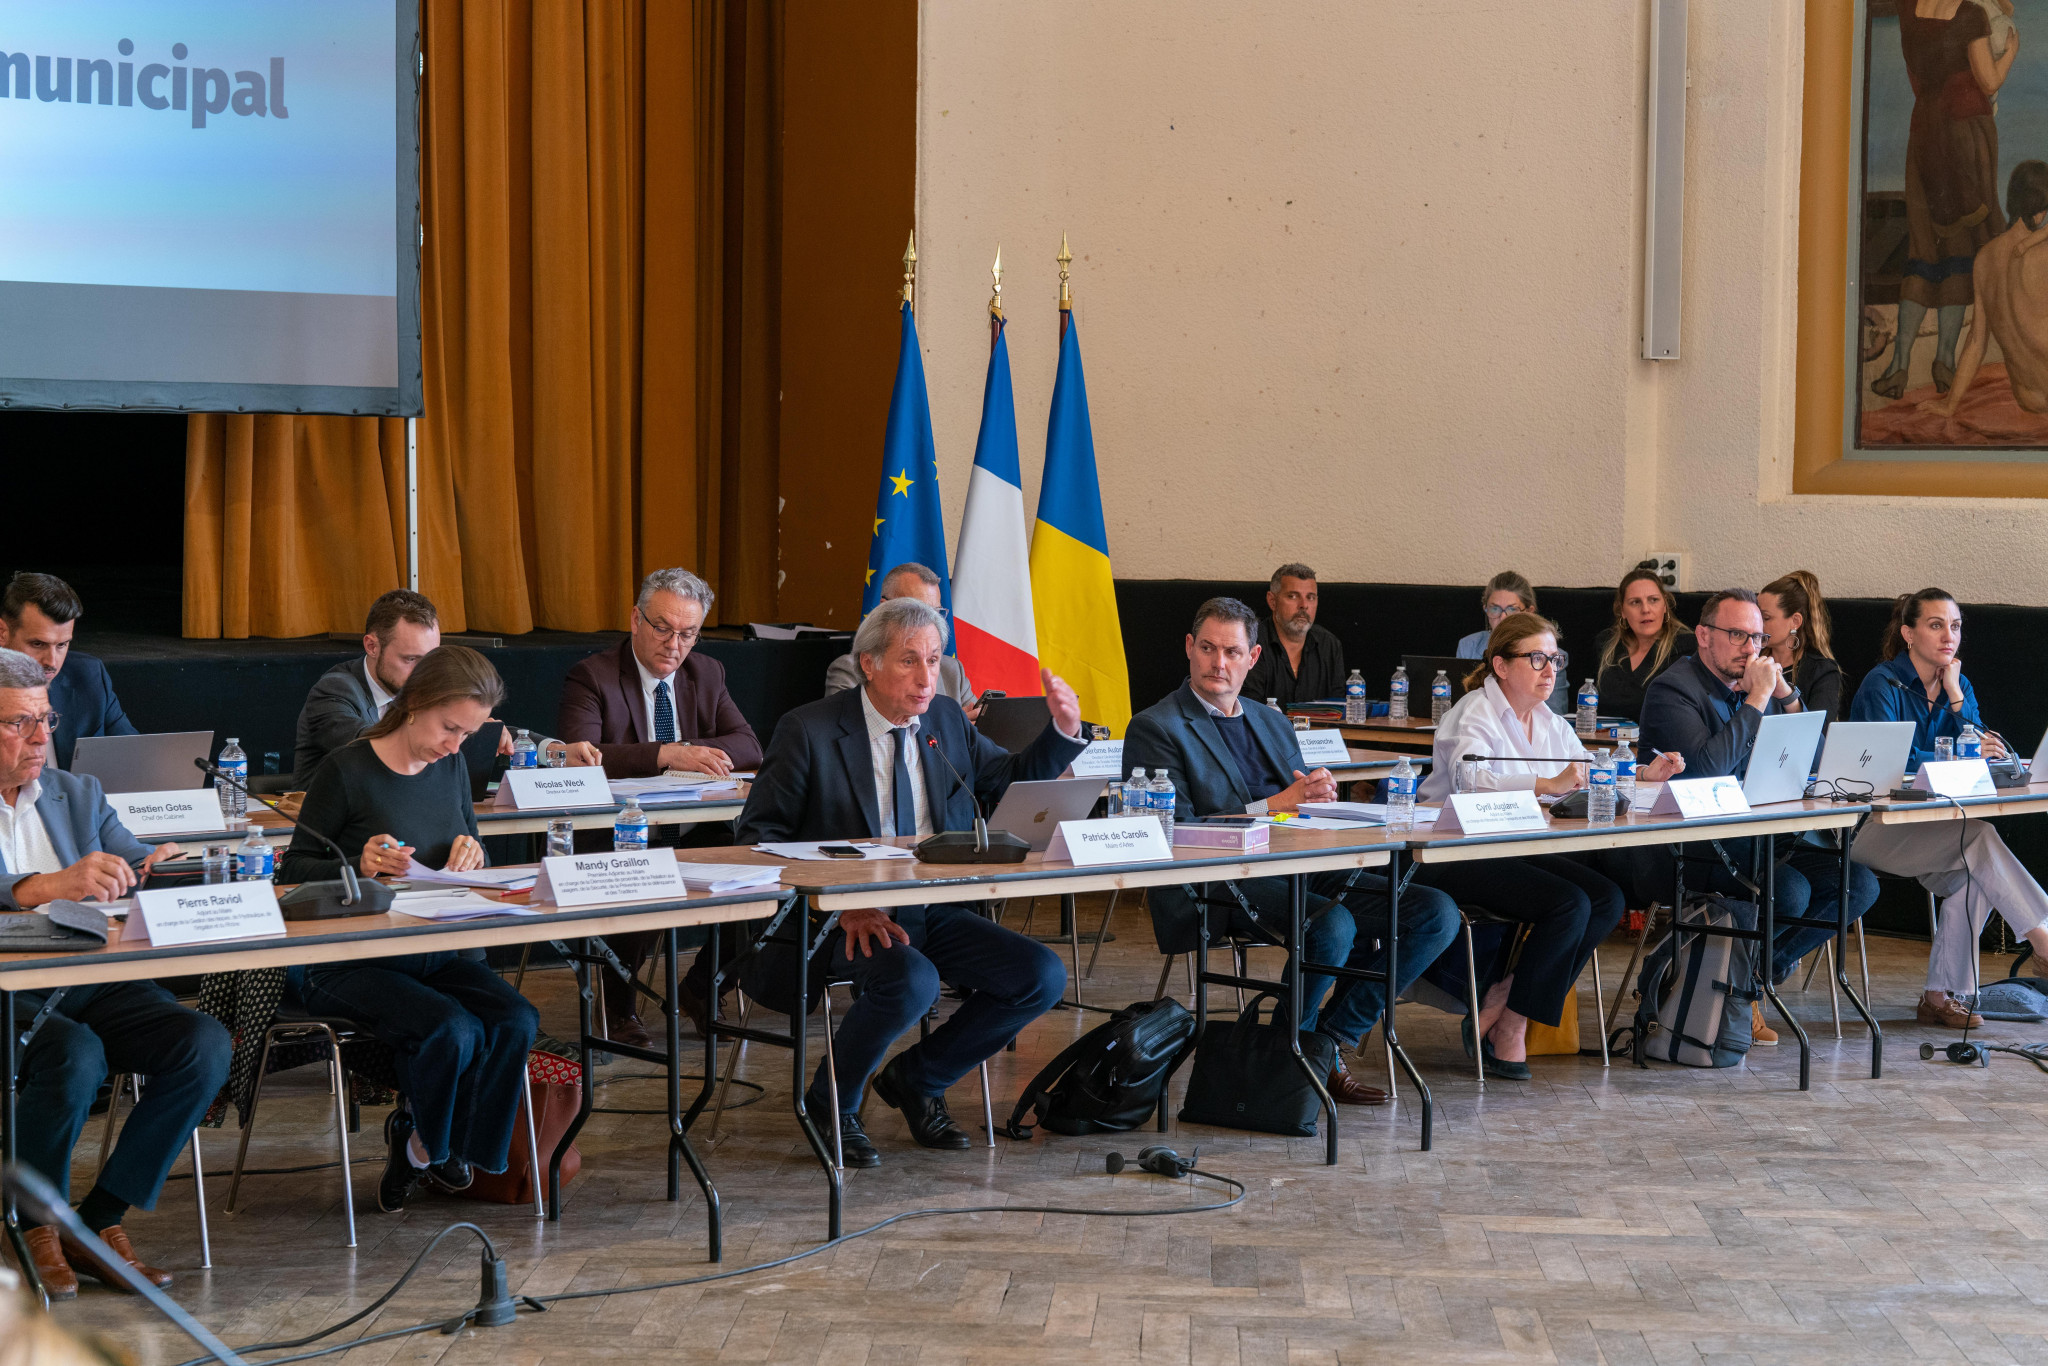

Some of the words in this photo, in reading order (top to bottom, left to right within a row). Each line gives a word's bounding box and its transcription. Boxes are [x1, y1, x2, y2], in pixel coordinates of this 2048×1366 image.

[0, 37, 289, 129] municipal
[1306, 738, 1334, 746] Dimanche
[534, 780, 563, 789] Nicolas
[563, 778, 586, 787] Weck
[128, 804, 164, 814] Bastien
[165, 803, 193, 812] Gotas
[1475, 802, 1492, 812] Cyril
[1493, 801, 1519, 812] Juglaret
[1081, 832, 1110, 842] Patrick
[1110, 831, 1121, 840] de
[1121, 829, 1149, 839] Carolis
[575, 859, 608, 871] Mandy
[610, 857, 650, 868] Graillon
[177, 897, 209, 909] Pierre
[209, 893, 243, 906] Raviol
